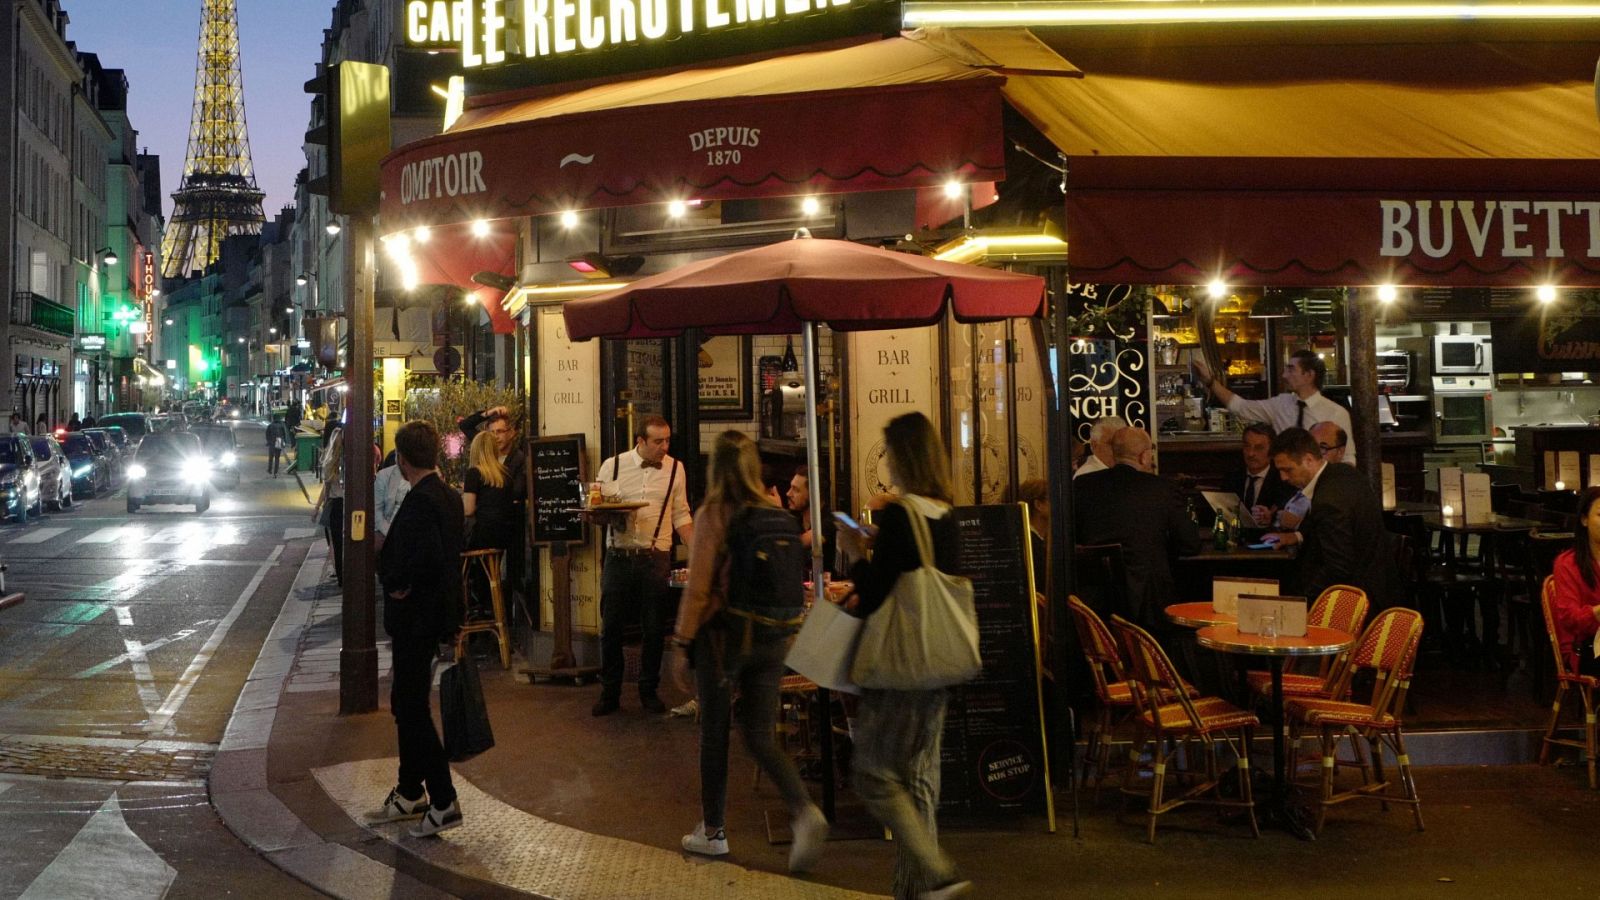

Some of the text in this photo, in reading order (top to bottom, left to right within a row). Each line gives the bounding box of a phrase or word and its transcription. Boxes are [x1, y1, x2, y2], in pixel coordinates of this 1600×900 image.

[408, 0, 486, 42] CAF
[463, 0, 505, 67] LE
[689, 127, 760, 152] DEPUIS
[707, 150, 741, 166] 1870
[401, 151, 487, 205] COMPTOIR
[145, 254, 153, 343] THOUMIEUX
[558, 359, 579, 372] BAR
[877, 349, 911, 366] BAR
[553, 391, 585, 405] GRILL
[868, 388, 916, 405] GRILL
